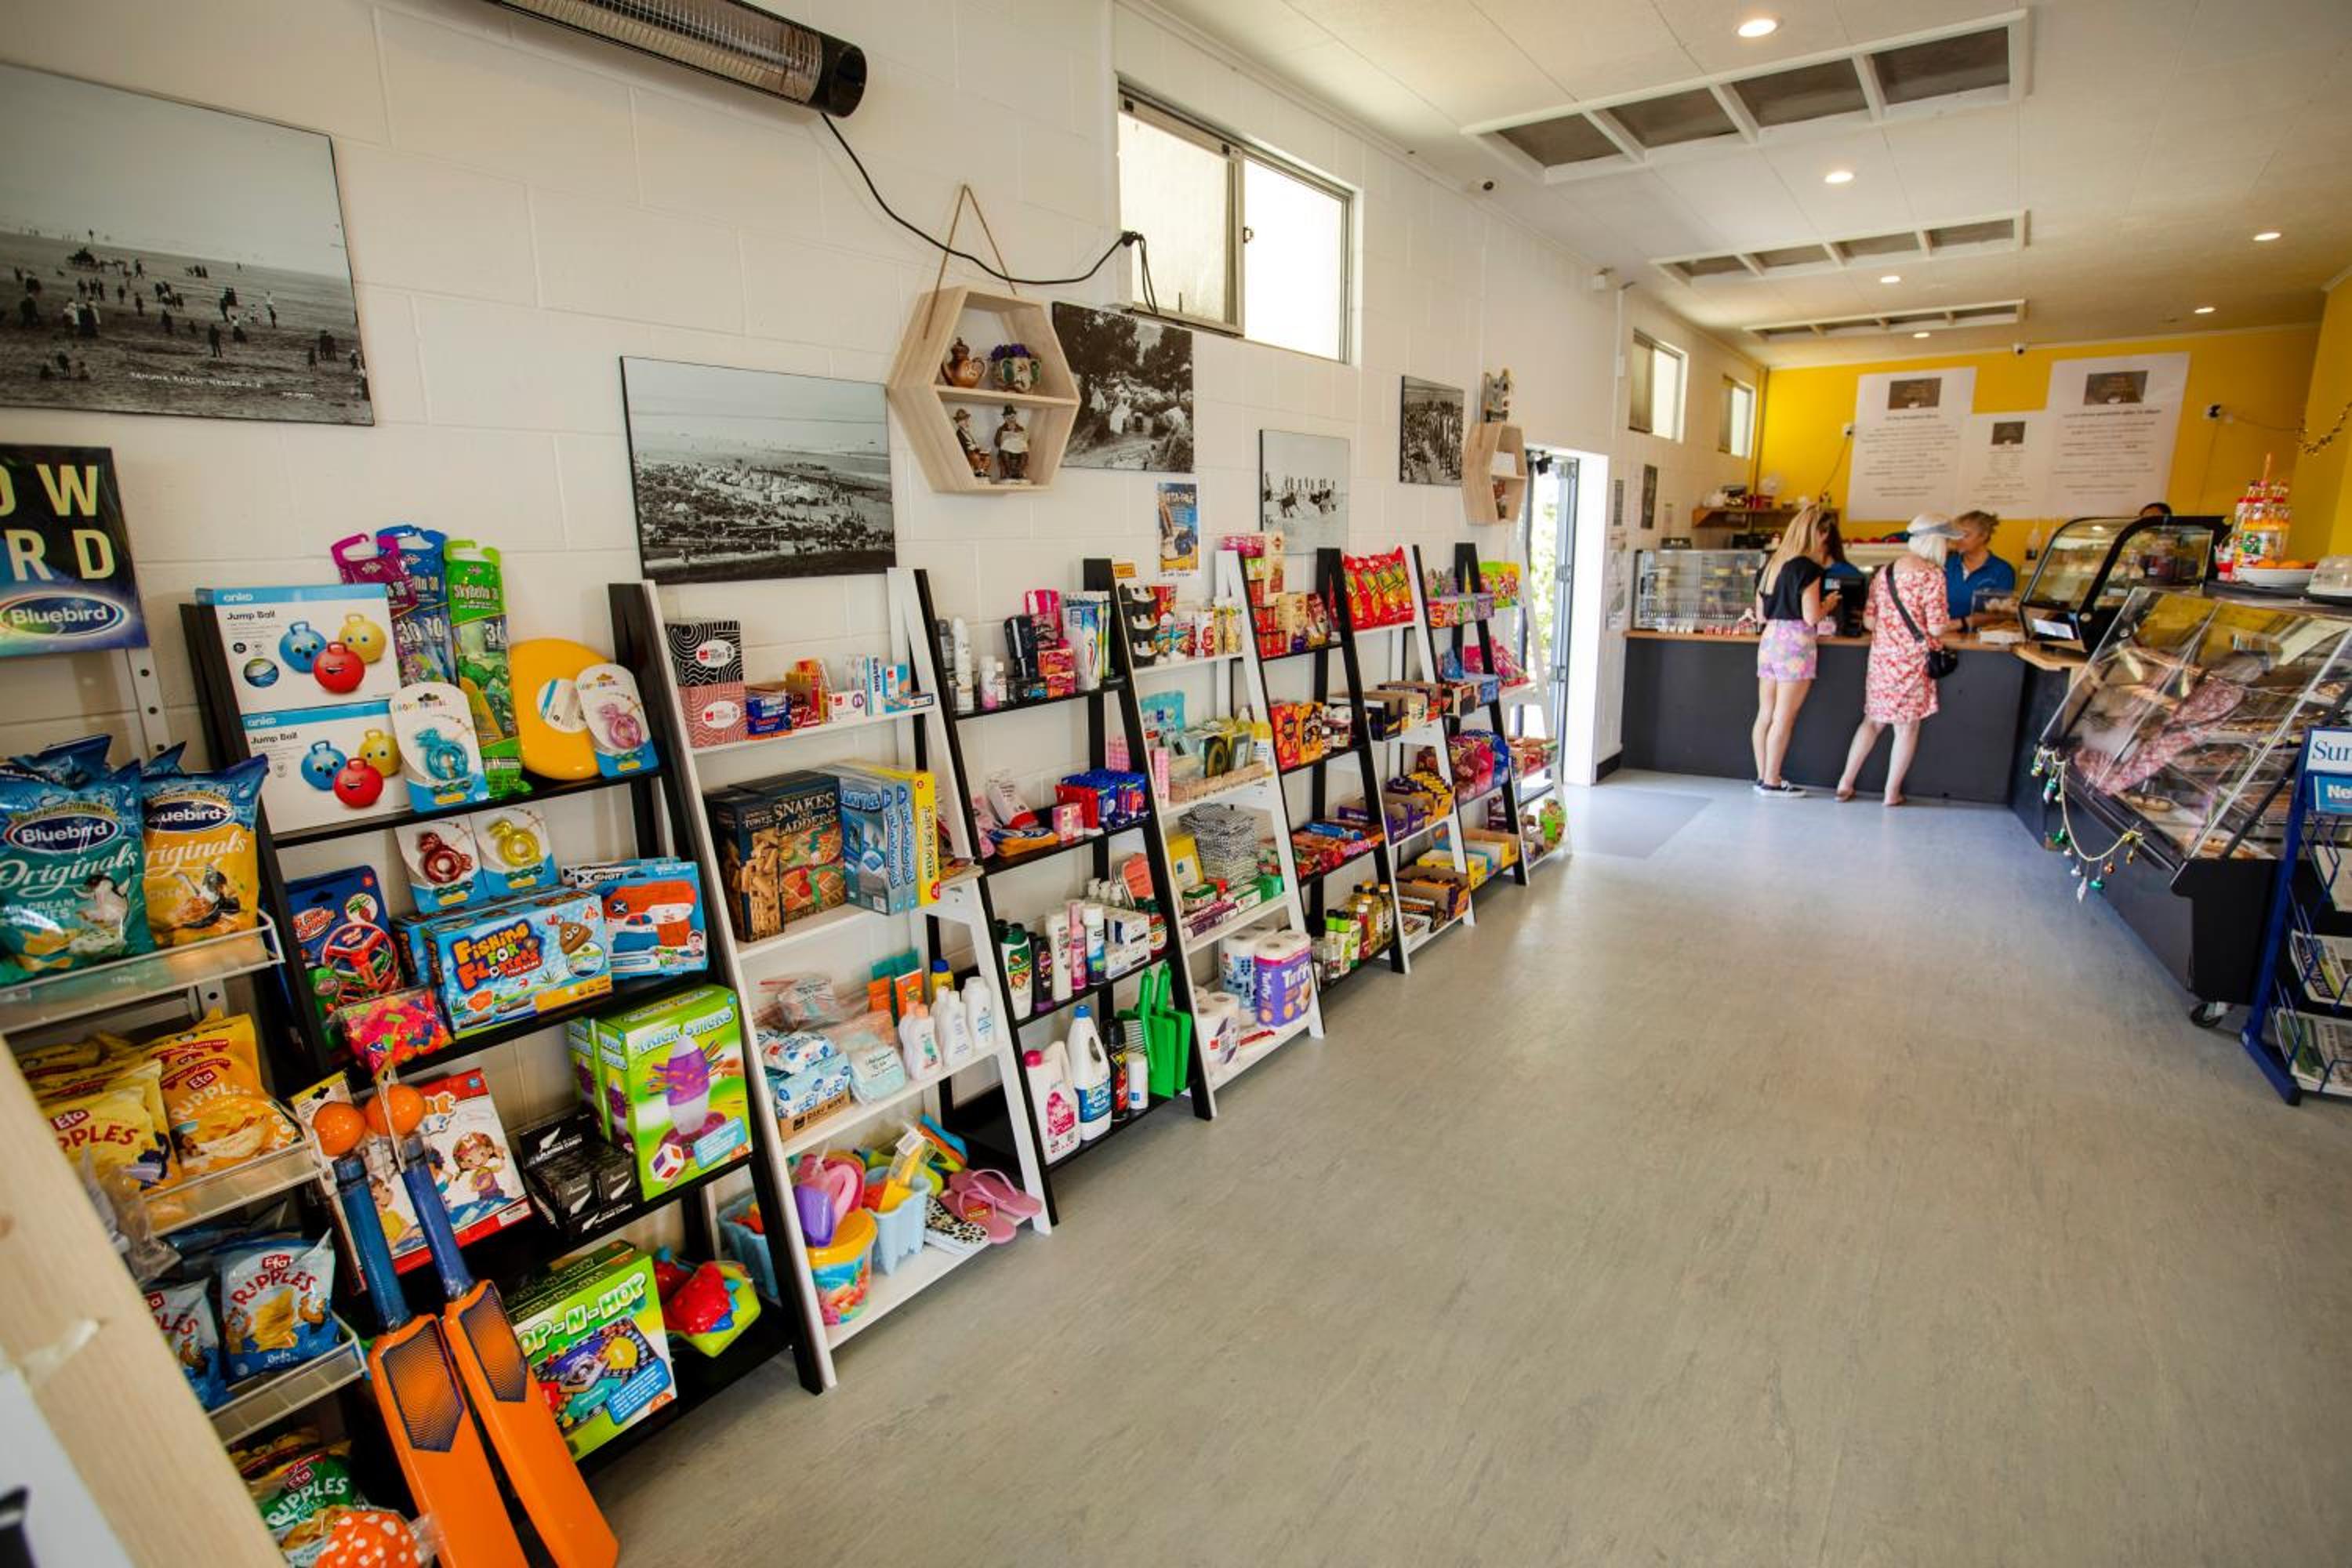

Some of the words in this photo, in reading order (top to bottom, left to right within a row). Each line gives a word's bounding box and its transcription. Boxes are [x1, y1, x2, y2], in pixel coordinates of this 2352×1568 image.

[11, 604, 108, 625] Bluebird
[227, 612, 255, 621] Jump
[257, 610, 276, 619] Ball
[250, 735, 278, 745] Jump
[280, 731, 298, 741] Ball
[774, 791, 837, 820] SNAKES
[21, 822, 108, 844] Bluebird
[776, 811, 837, 837] LADDERS
[145, 833, 247, 877] riginals
[488, 943, 520, 966] FOR
[230, 1269, 318, 1306] RIPPLES
[518, 1272, 646, 1356] OP-N-HOP
[267, 1477, 348, 1526] RIPPLES
